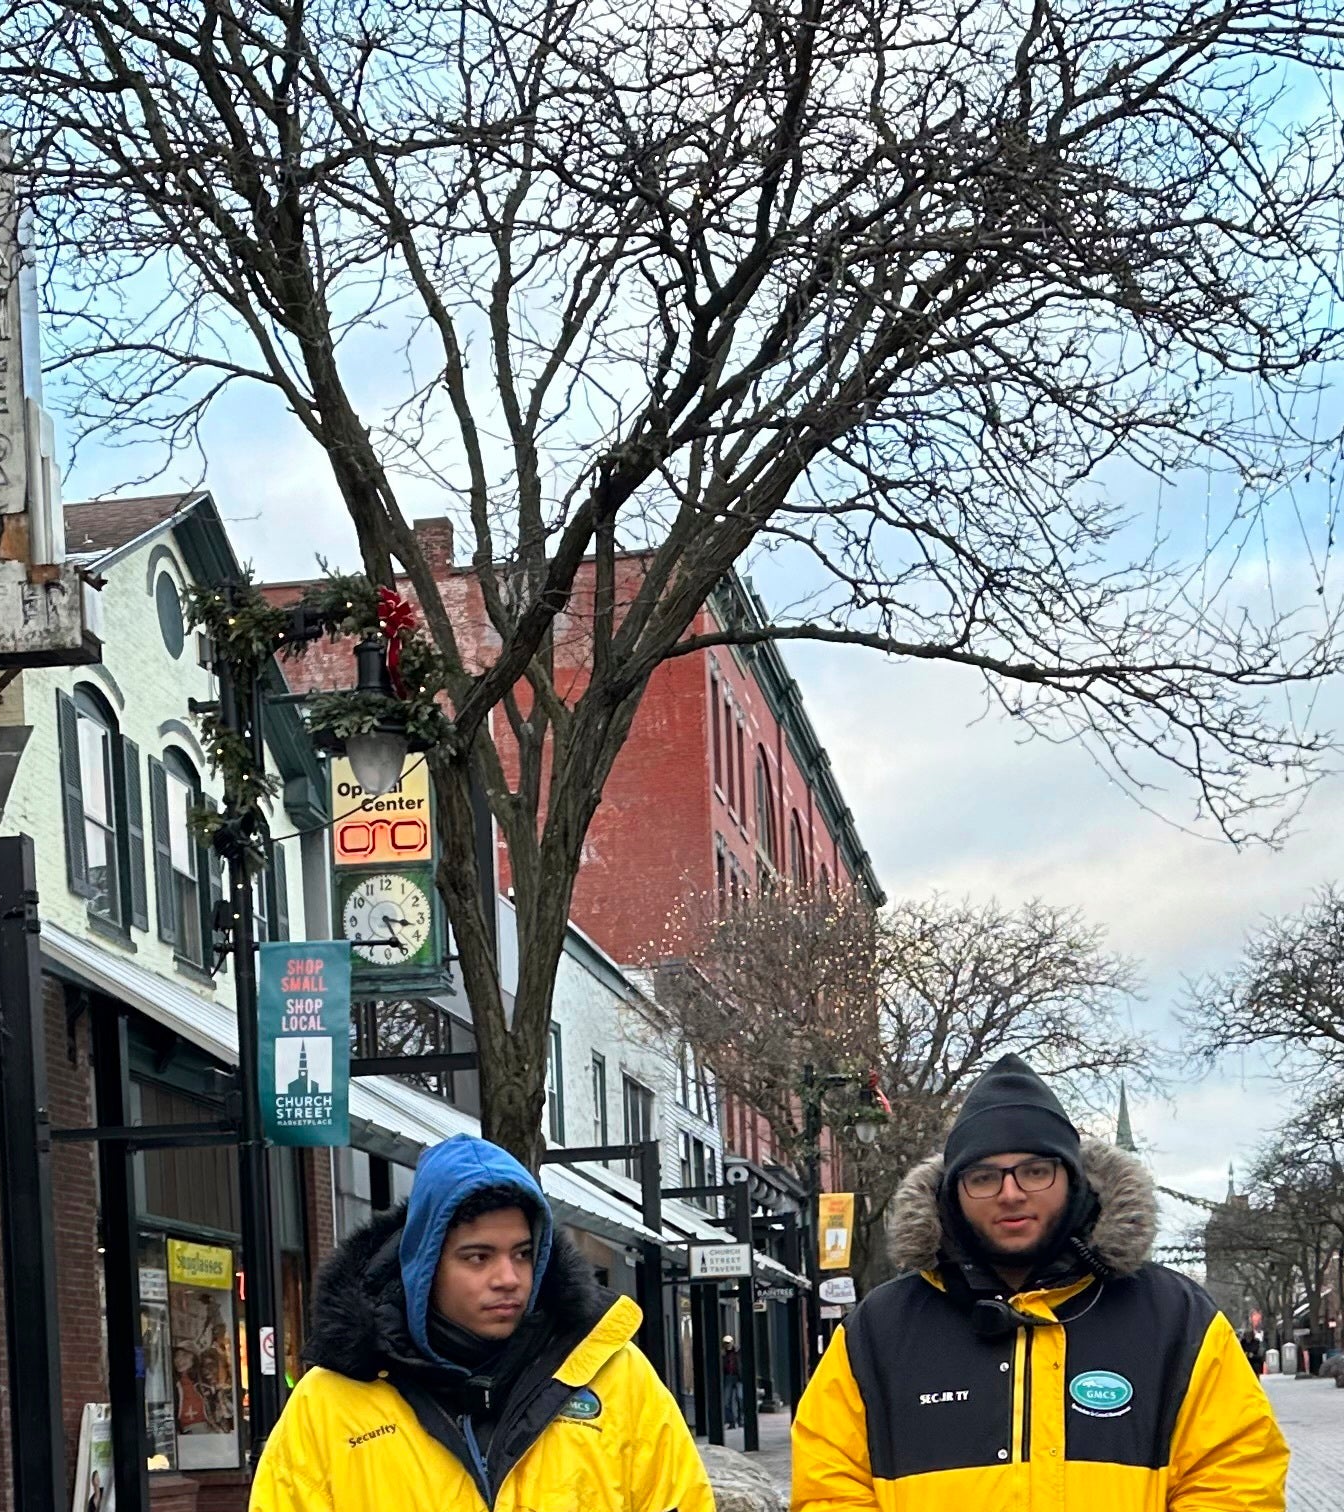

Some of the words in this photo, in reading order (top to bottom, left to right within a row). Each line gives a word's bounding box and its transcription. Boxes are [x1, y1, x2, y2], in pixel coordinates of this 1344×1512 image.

[337, 780, 403, 799] Opal
[361, 797, 424, 812] Center
[366, 884, 374, 896] 11
[380, 879, 392, 891] 12
[401, 883, 405, 895] 1
[353, 897, 365, 909] 10
[412, 896, 420, 907] 2
[417, 912, 425, 924] 3
[412, 930, 421, 942] 4
[287, 959, 324, 975] SHOP
[286, 998, 323, 1014] SHOP
[276, 1096, 332, 1108] CHURCH
[276, 1107, 332, 1119] STREET
[757, 1288, 794, 1297] RAINTREE
[1086, 1390, 1117, 1400] GMCS
[348, 1423, 397, 1448] Security
